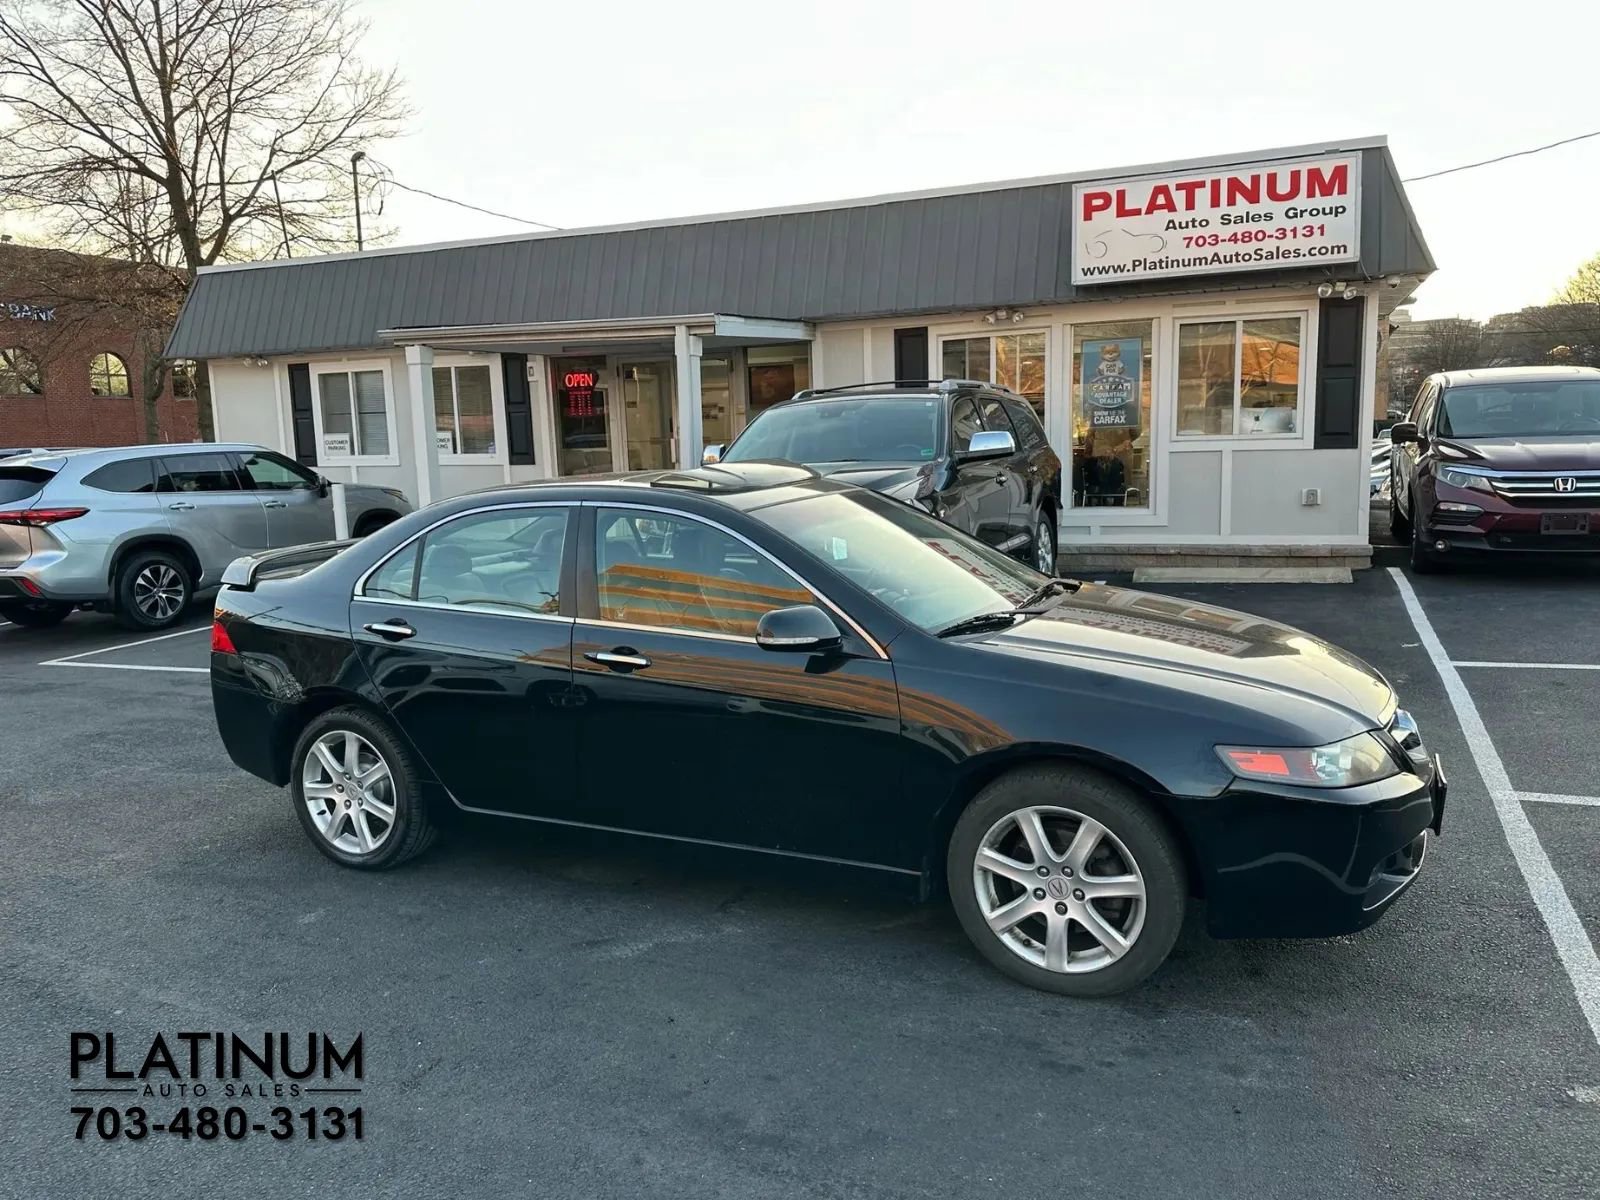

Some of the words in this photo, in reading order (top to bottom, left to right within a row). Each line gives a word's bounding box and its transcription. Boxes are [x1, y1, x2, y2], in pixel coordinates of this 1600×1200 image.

[1082, 164, 1348, 222] PLATINUM
[1164, 218, 1210, 231] Auto
[1220, 211, 1274, 226] Sales
[1284, 205, 1347, 220] Group
[1182, 224, 1326, 249] 703-480-3131
[1081, 244, 1348, 277] www.PlatinumAutoSales.com
[565, 373, 593, 387] OPEN
[1094, 415, 1126, 424] CARFAX
